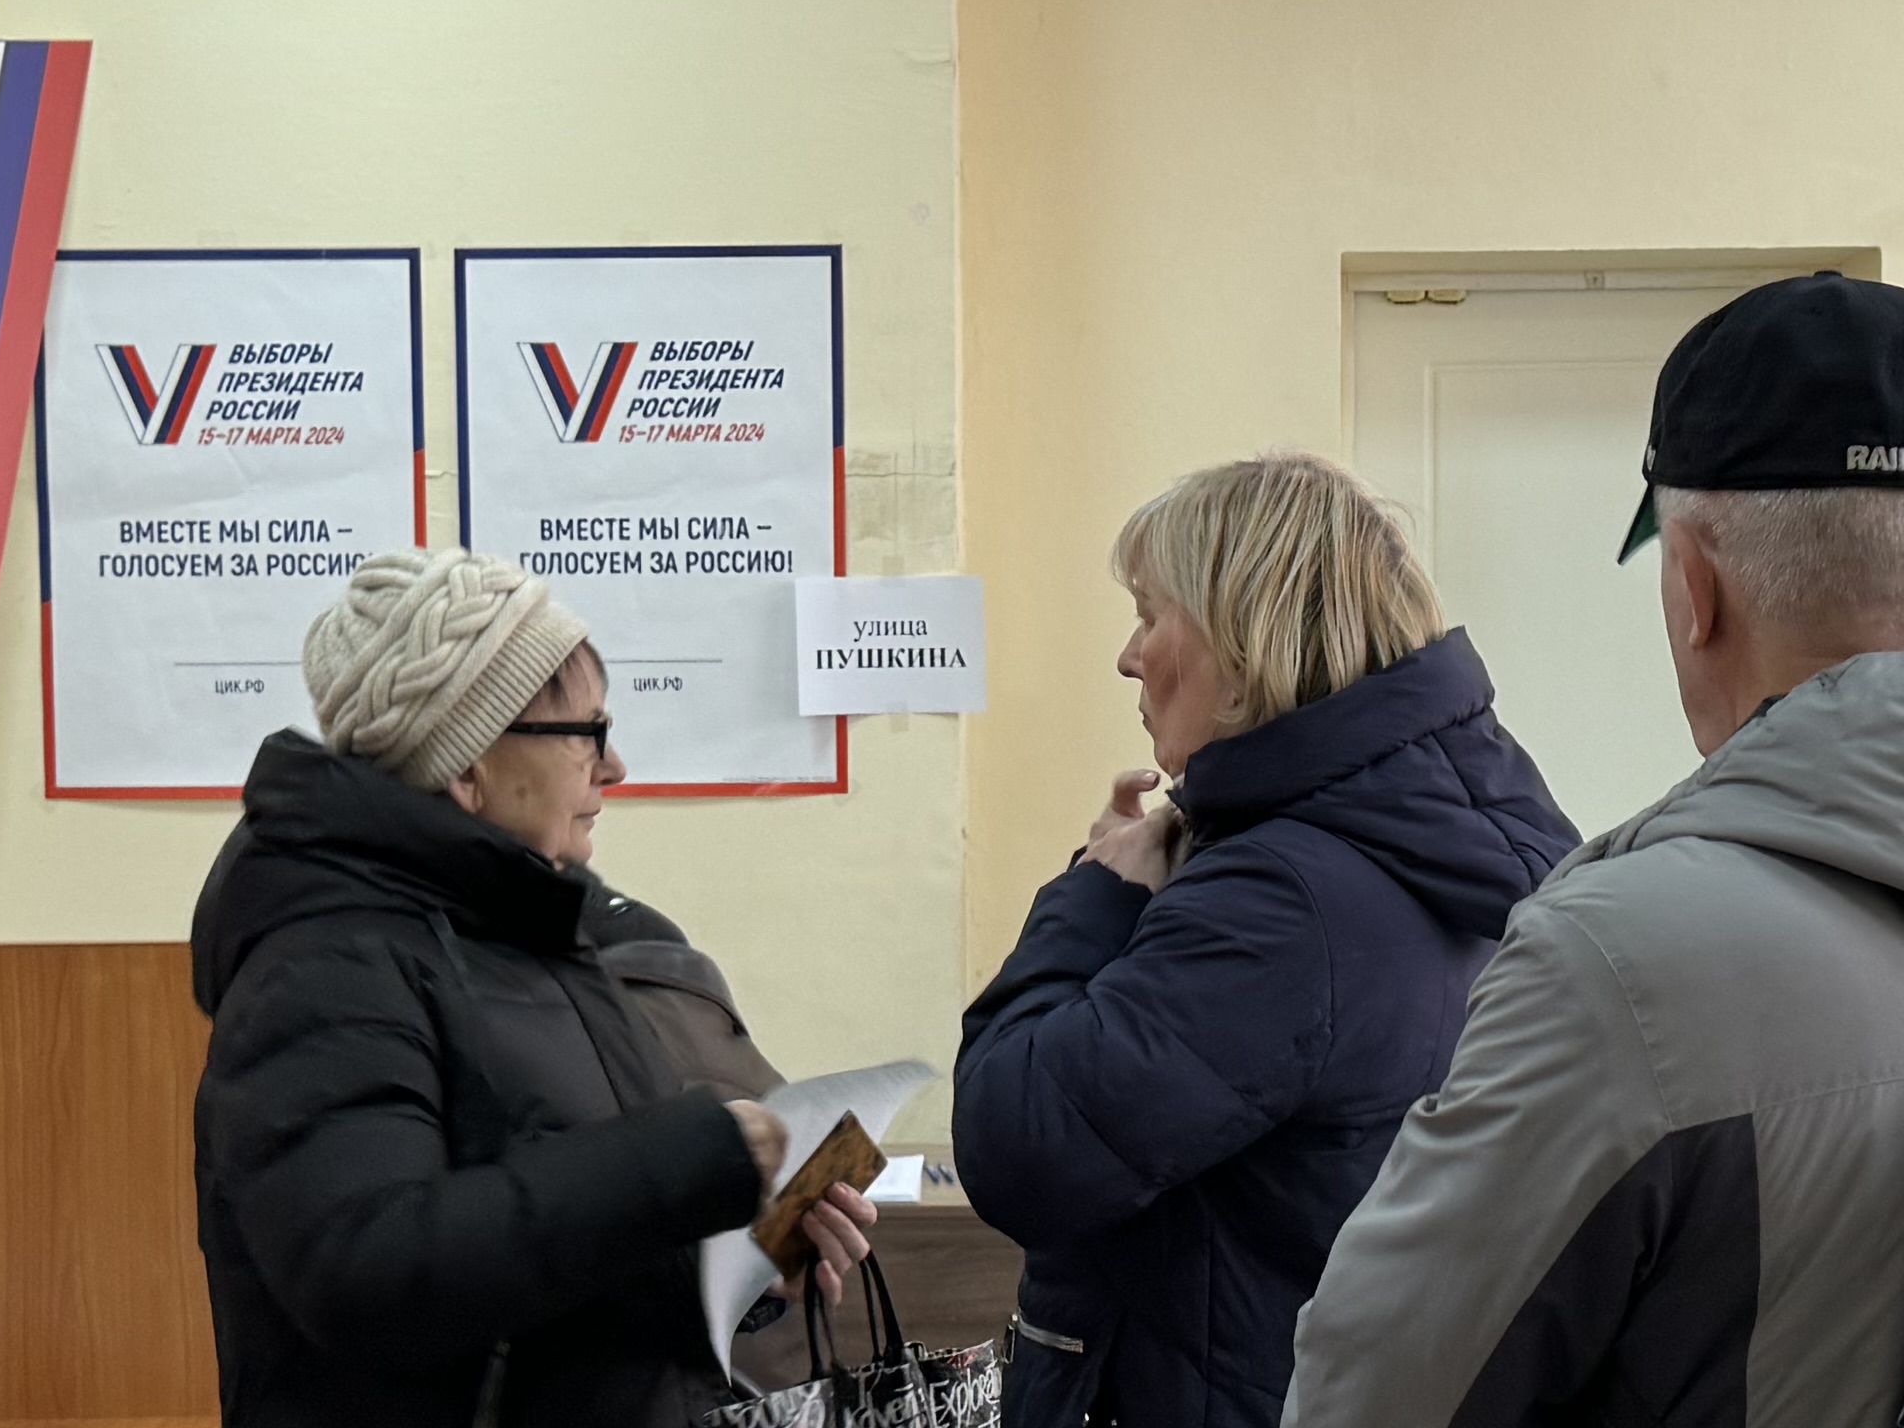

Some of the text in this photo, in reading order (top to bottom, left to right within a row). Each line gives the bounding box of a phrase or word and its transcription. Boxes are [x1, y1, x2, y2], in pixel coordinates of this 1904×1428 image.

[228, 342, 334, 364] ВЫБОРЫ
[649, 340, 755, 362] ВЫБОРЫ
[216, 371, 365, 395] ПРЕЗИДЕНТА
[637, 368, 785, 393] ПРЕЗИДЕНТА
[206, 399, 301, 421] РОССИИ
[626, 398, 721, 419] РОССИИ
[245, 427, 301, 445] МАРТА
[304, 427, 345, 445] 2024
[665, 424, 722, 443] МАРТА
[724, 423, 766, 442] 2024
[119, 519, 211, 543] ВМЕСТЕ
[219, 519, 260, 543] МЫ
[267, 519, 331, 543] СИЛА
[540, 518, 631, 542] ВМЕСТЕ
[639, 517, 679, 541] МЫ
[687, 516, 750, 540] СИЛА
[99, 552, 373, 577] ГОЛОСУЕМ ЗА РОССИЮ
[520, 550, 793, 575] ГОЛОСУЕМ ЗА РОССИЮ!
[853, 619, 928, 643] улица
[816, 647, 967, 670] ПУШКИНА
[214, 679, 265, 695] ЦИК.РФ
